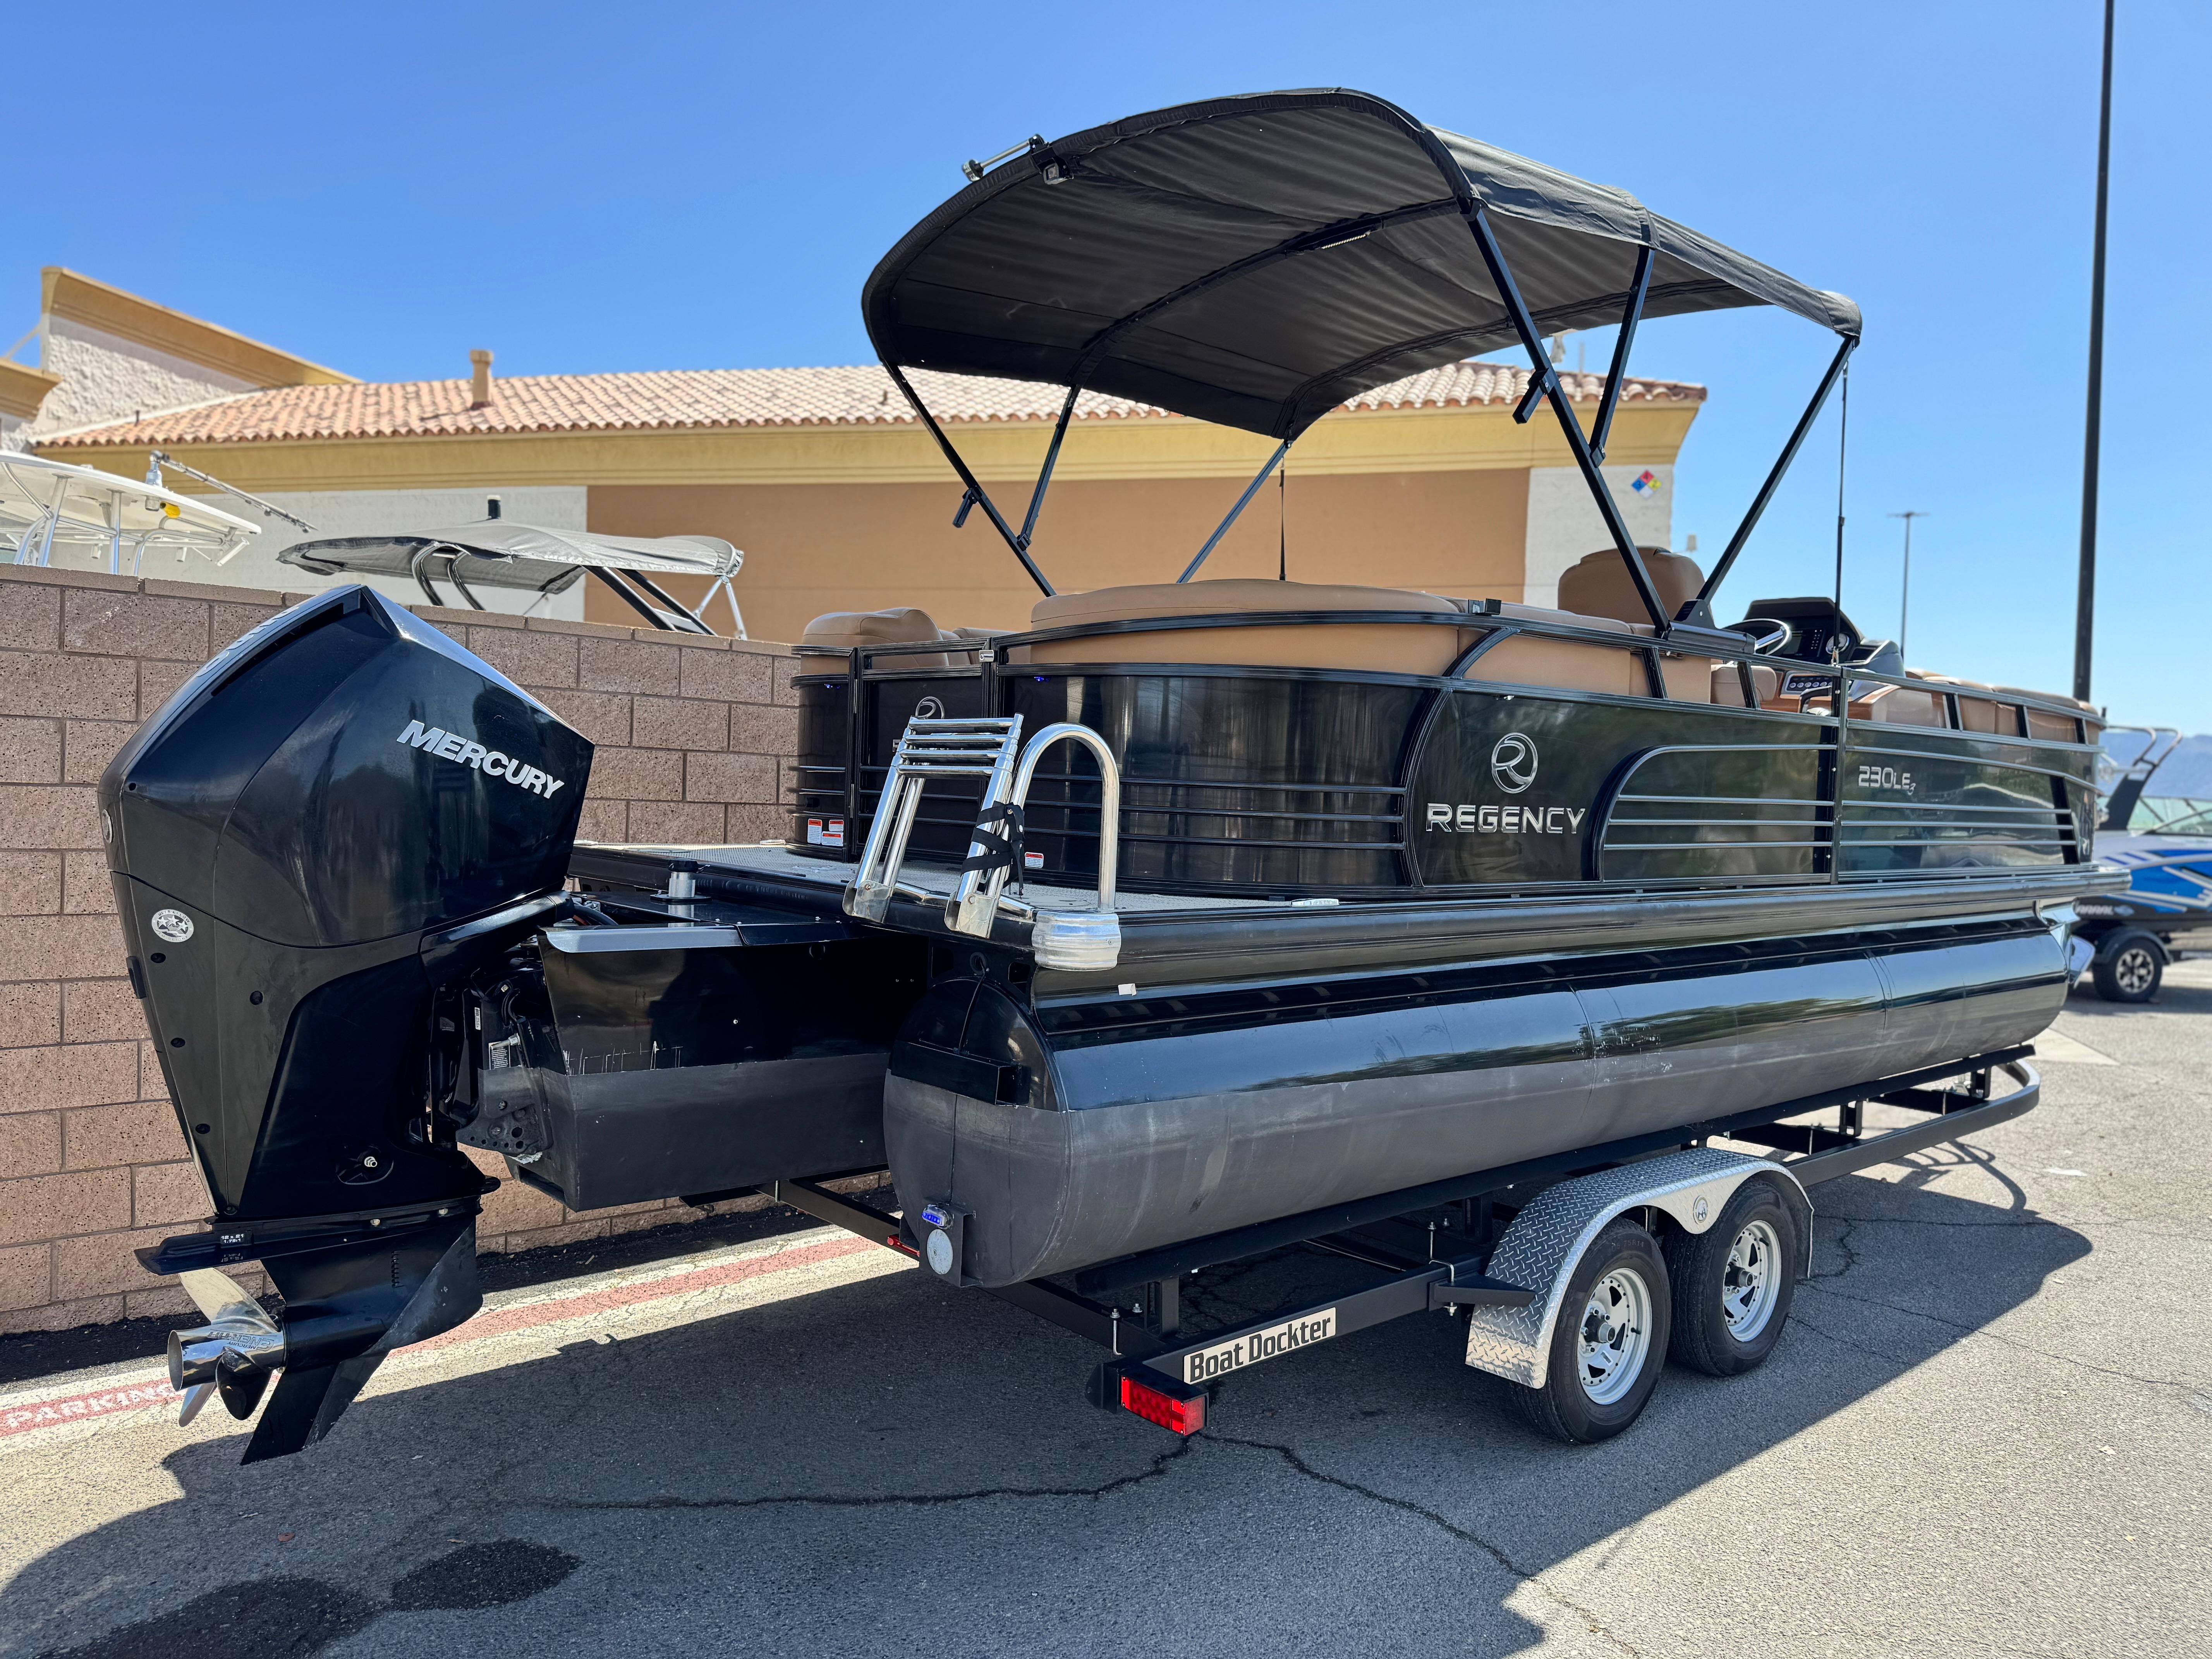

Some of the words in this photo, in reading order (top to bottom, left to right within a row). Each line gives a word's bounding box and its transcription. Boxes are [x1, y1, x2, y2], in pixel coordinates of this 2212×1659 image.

[396, 719, 565, 799] MERCURY
[1426, 803, 1585, 834] REGENCY
[1190, 1343, 1243, 1383] Boat
[1249, 1317, 1331, 1362] Dockter
